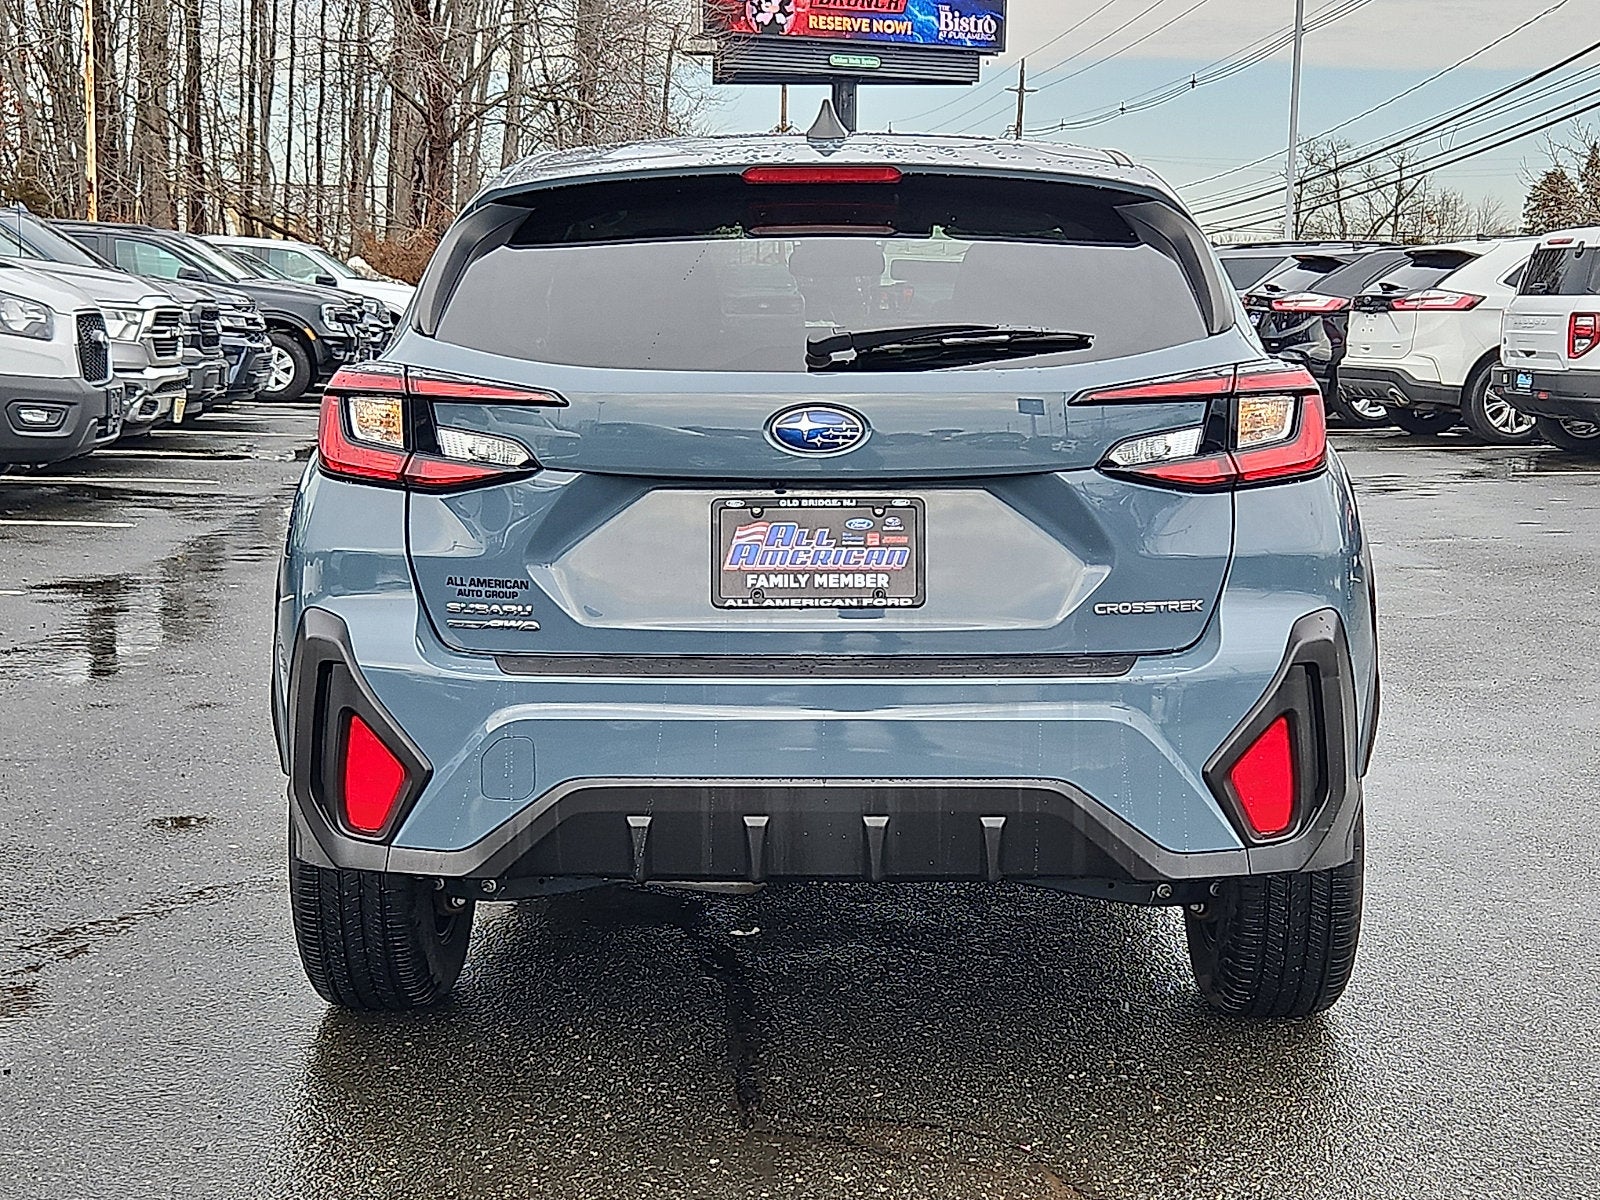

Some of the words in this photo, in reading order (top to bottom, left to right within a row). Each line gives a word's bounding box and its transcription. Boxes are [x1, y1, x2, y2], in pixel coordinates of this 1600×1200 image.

[808, 14, 870, 33] RESERVE
[873, 19, 912, 35] NOW!
[765, 522, 837, 547] ALL
[724, 543, 910, 570] AMERICAN
[446, 576, 466, 587] ALL
[469, 578, 529, 590] AMERICAN
[746, 574, 810, 588] FAMILY
[814, 574, 889, 588] MEMBER
[457, 589, 483, 598] AUTO
[485, 590, 518, 599] GROUP
[446, 602, 533, 616] SUBARU
[724, 598, 758, 607] ALL
[759, 598, 860, 607] AMERICAN
[862, 598, 913, 607] FORD
[1094, 600, 1204, 614] CROSSTREK
